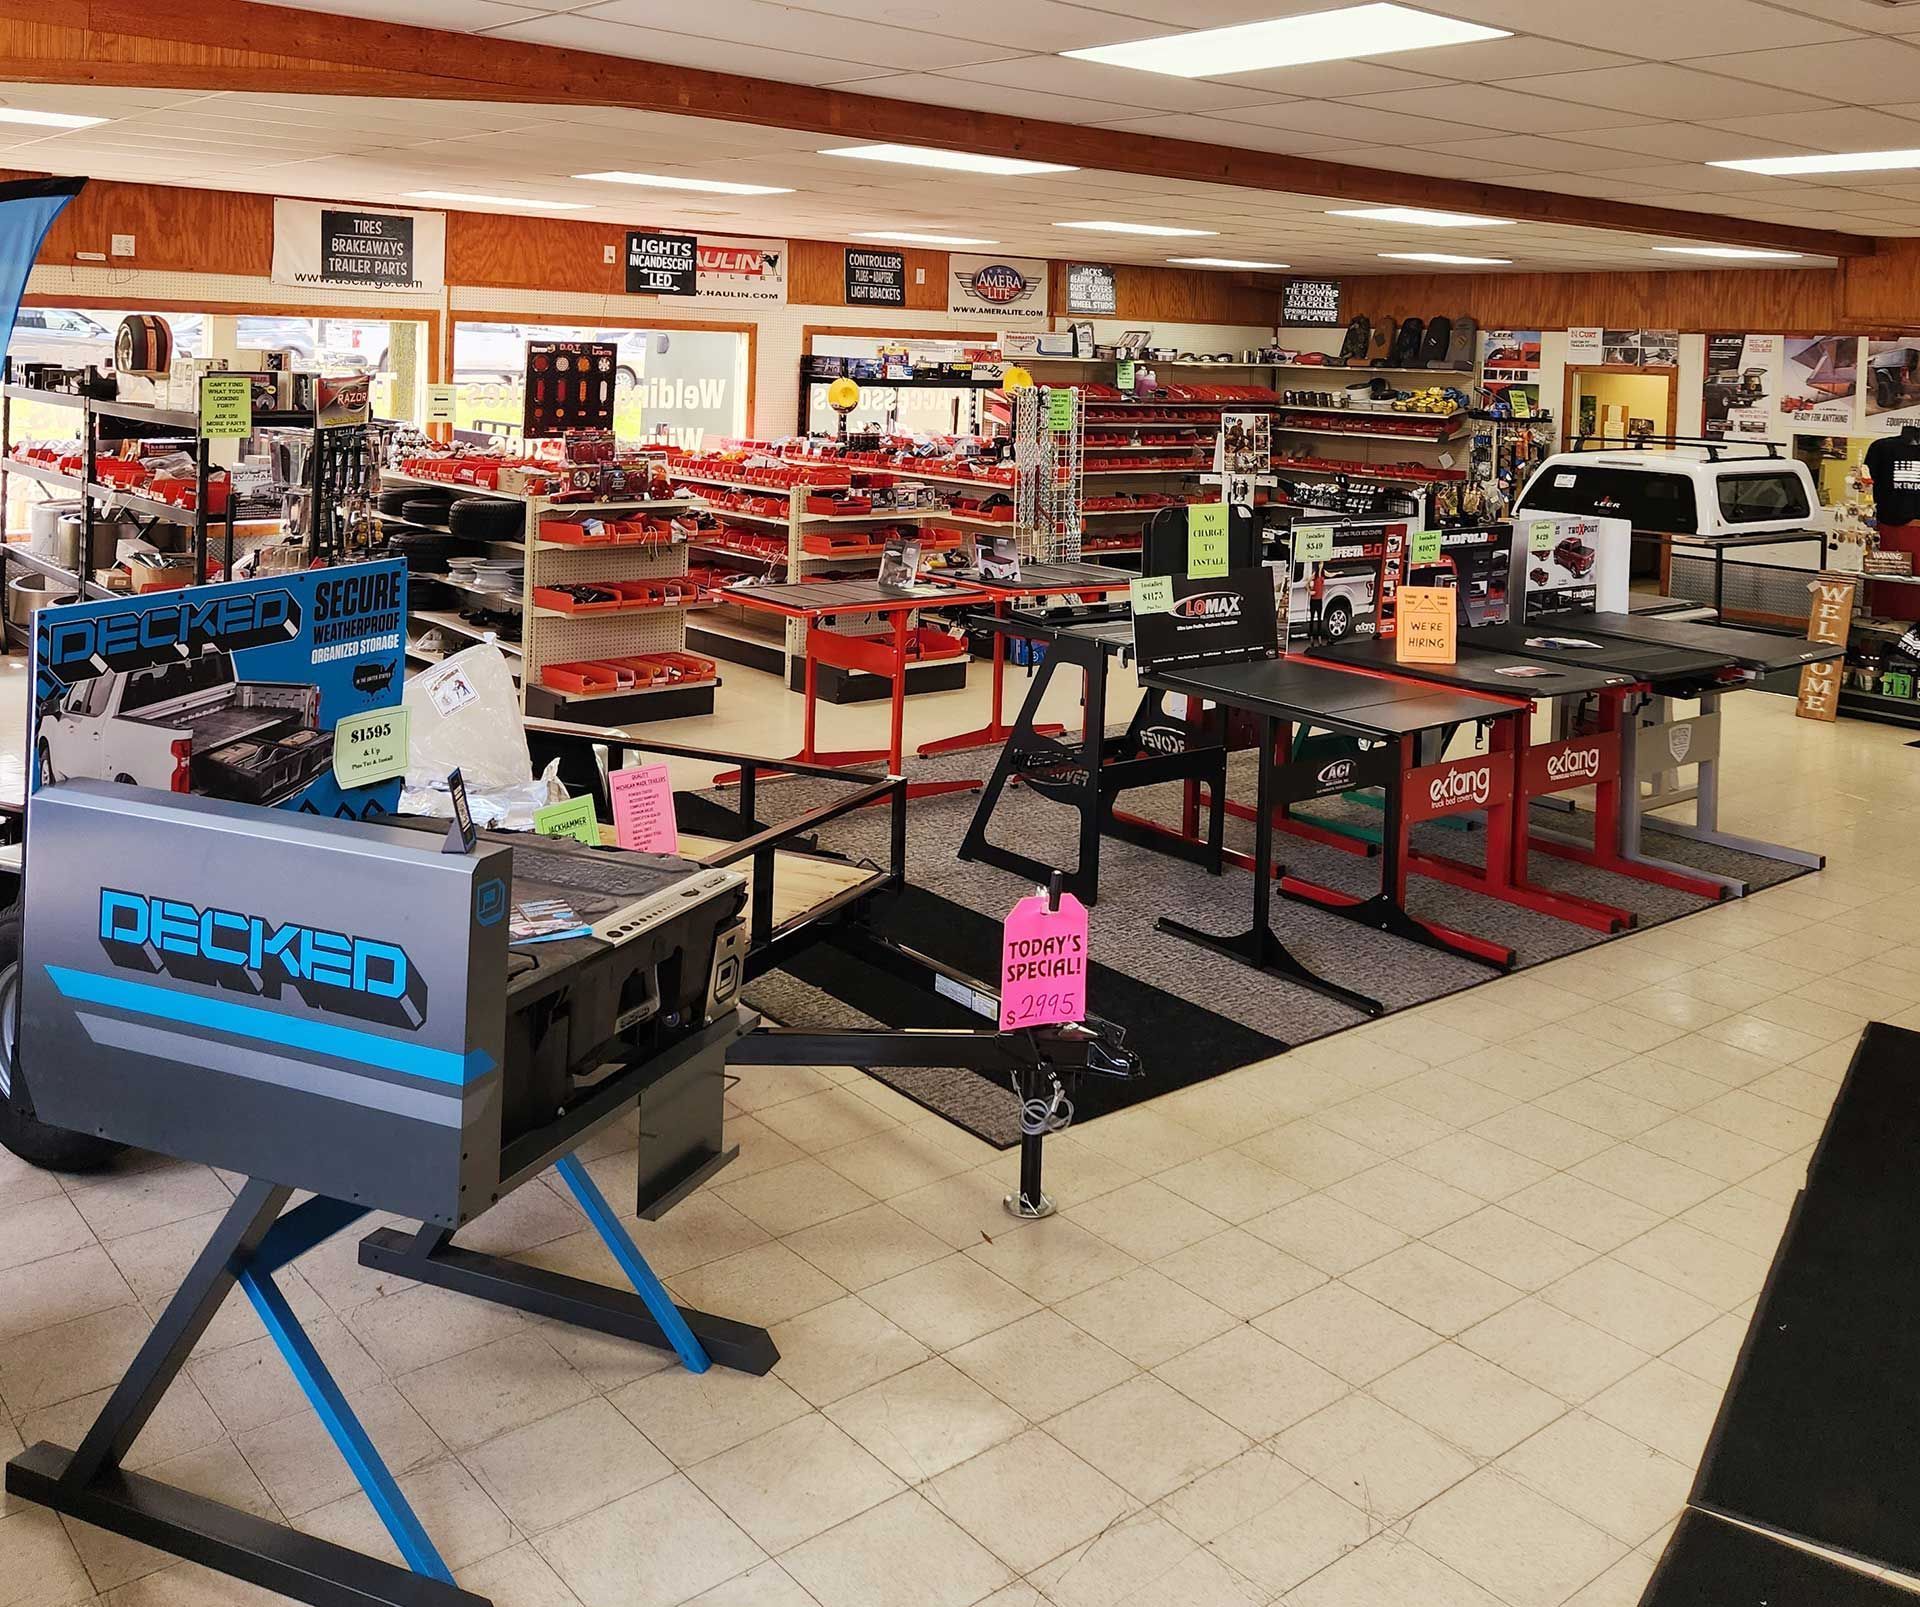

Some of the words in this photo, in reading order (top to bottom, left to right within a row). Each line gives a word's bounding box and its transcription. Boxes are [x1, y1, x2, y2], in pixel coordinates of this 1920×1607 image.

[353, 219, 383, 235] TIRES
[331, 237, 404, 256] BRAKEAWAYS
[631, 238, 692, 257] LIGHTS
[328, 257, 371, 274] TRAILER
[374, 262, 408, 276] PARTS
[629, 254, 694, 271] INCANDESCENT
[849, 253, 902, 270] CONTROLLERS
[649, 273, 673, 287] LED
[977, 271, 1022, 289] AMERA
[1080, 267, 1103, 277] JACKS
[850, 285, 869, 299] LIGHT
[869, 286, 901, 301] BRACKETS
[987, 287, 1011, 300] LITE
[1071, 283, 1086, 291] DUST
[1088, 284, 1112, 293] COVERS
[1285, 287, 1299, 295] TIE
[1301, 288, 1339, 298] DOWNS
[1292, 282, 1332, 290] U-BOLTS
[952, 306, 1043, 317] WWW.AMERALITE.COM
[1287, 300, 1336, 309] SHACKLES
[1307, 309, 1338, 317] HANGERS
[336, 391, 368, 407] RAZOR
[1793, 412, 1809, 421] READY
[1810, 412, 1821, 422] FOR
[1821, 413, 1849, 424] ANYTHING
[1593, 500, 1621, 509] LEER
[1203, 514, 1215, 522] NO
[1193, 528, 1225, 538] CHARGE
[1203, 543, 1215, 551] TO
[1193, 557, 1226, 567] INSTALL
[314, 571, 401, 622] SECURE
[1185, 597, 1241, 617] LOMAX
[49, 589, 295, 675] DECKED
[313, 612, 400, 645] WEATHERPROOF
[1410, 621, 1444, 632] WE'RE
[311, 641, 359, 665] ORGANIZED
[360, 633, 400, 655] STORAGE
[1408, 636, 1445, 649] HIRING
[1804, 585, 1853, 712] WELOME
[350, 723, 392, 744] $1595
[363, 749, 370, 757] &
[1546, 745, 1600, 778] extang
[632, 771, 650, 781] QUALITY
[1326, 762, 1351, 780] ACI
[1429, 766, 1490, 804] extang
[1431, 799, 1445, 809] truck
[1445, 796, 1457, 806] bed
[1456, 793, 1474, 803] covers
[100, 887, 418, 1014] DECKED
[1008, 934, 1081, 959] TODAY'S
[1007, 957, 1081, 983] SPECIAL!
